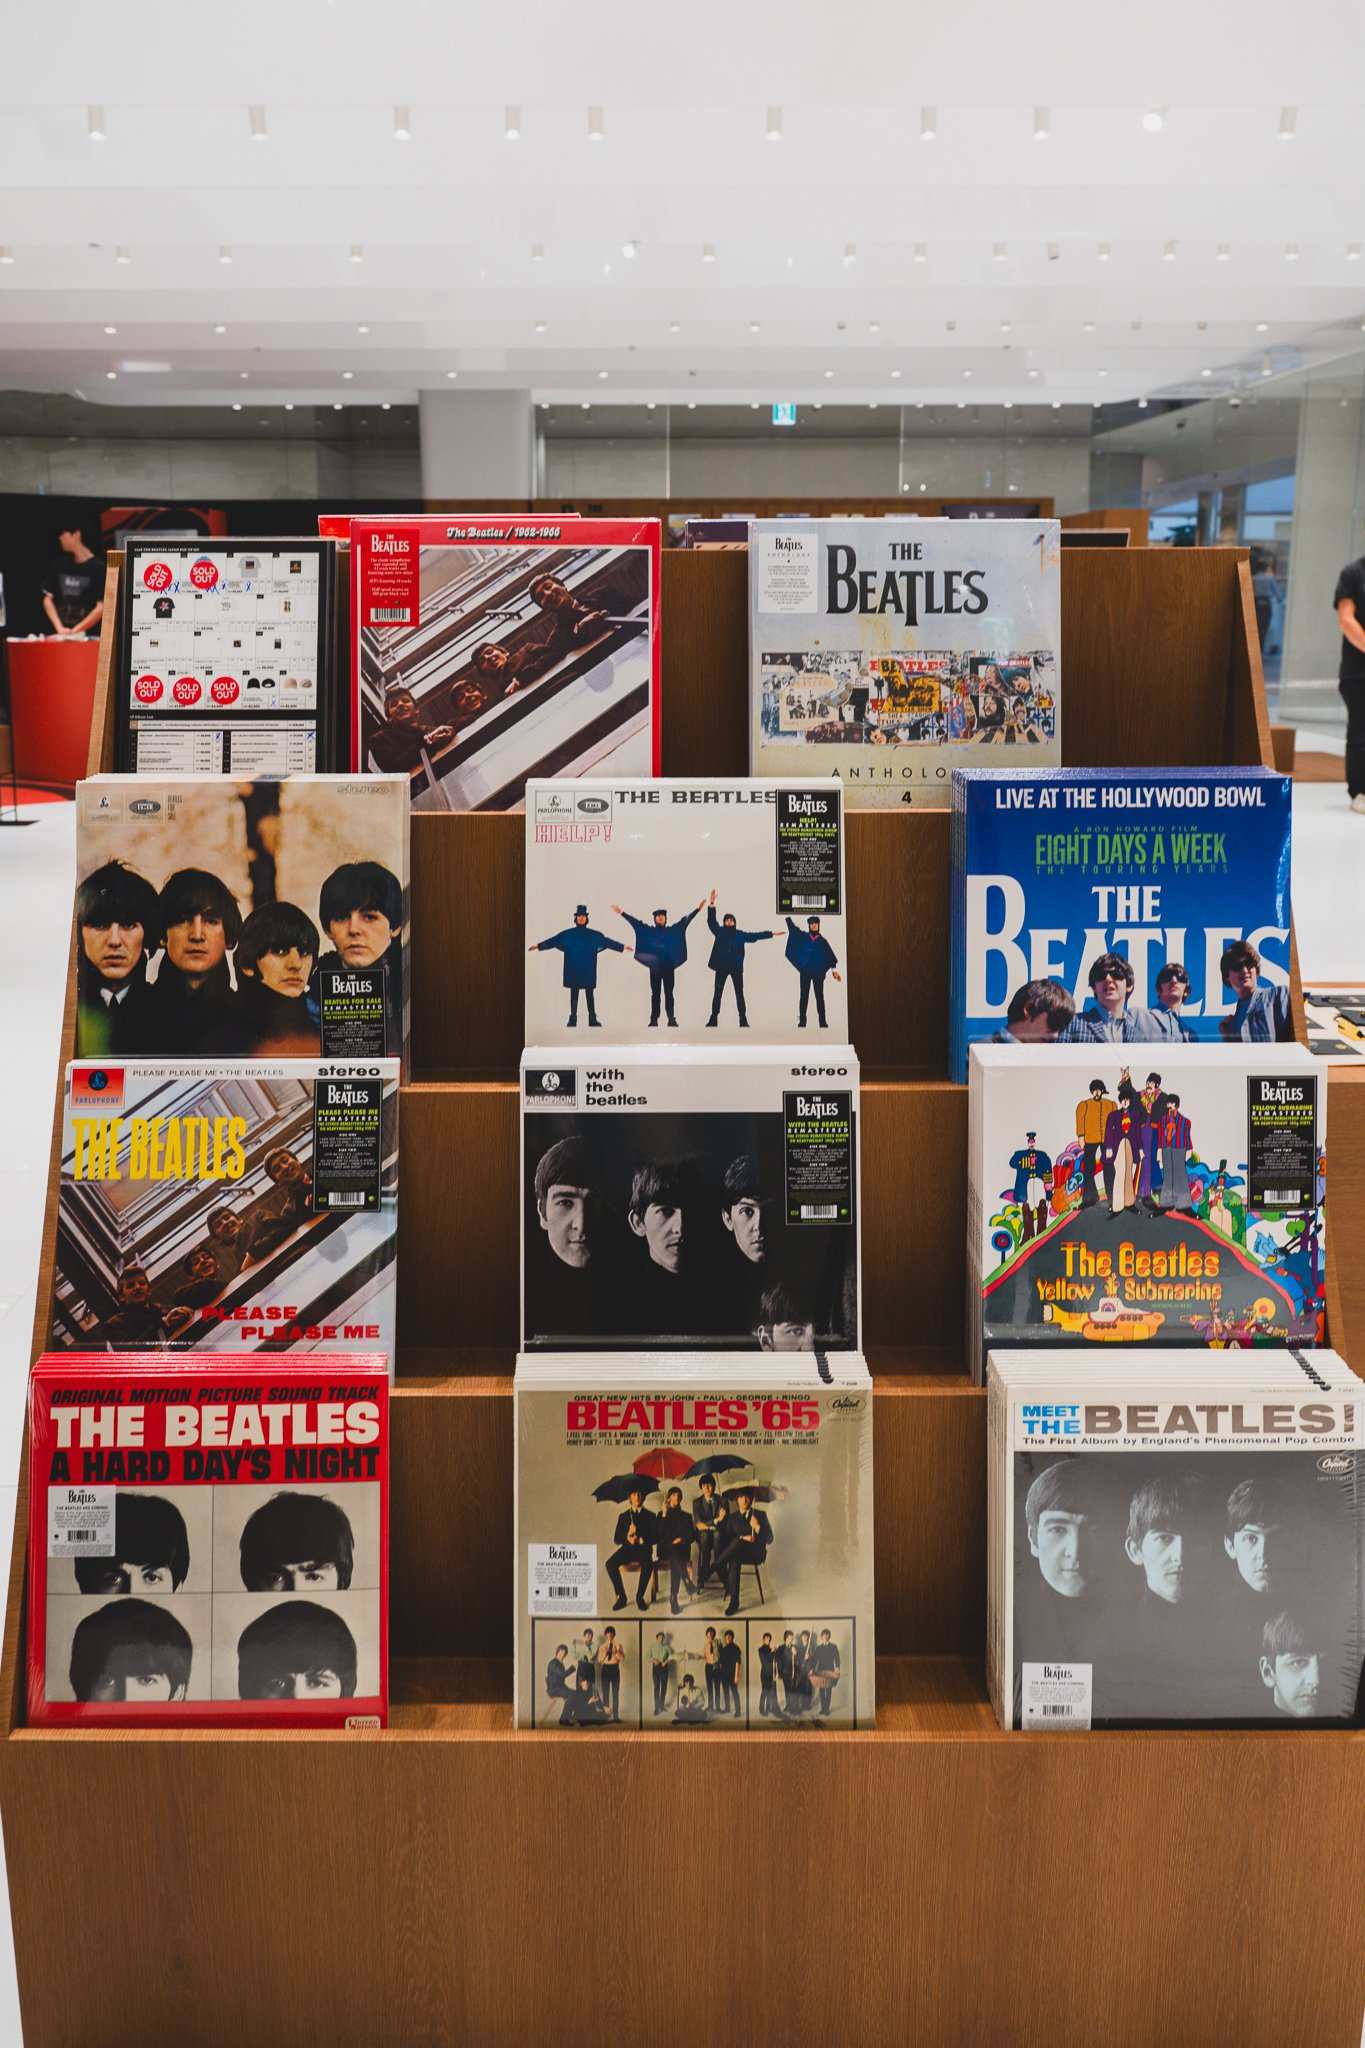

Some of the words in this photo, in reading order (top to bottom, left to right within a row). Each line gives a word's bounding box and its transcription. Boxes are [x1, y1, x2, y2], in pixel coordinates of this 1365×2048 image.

[447, 527, 466, 538] The
[468, 527, 504, 538] Beatles
[514, 527, 560, 538] 1962-1966
[372, 534, 410, 555] BEATLES
[776, 538, 802, 551] BEATLES
[888, 543, 922, 560] THE
[146, 564, 162, 587] SOLD
[156, 568, 168, 588] OUT
[192, 566, 216, 575] SOLD
[194, 575, 213, 583] OUT
[826, 544, 988, 626] BEATLES
[138, 680, 160, 689] SOLD
[176, 682, 199, 692] SOLD
[214, 682, 236, 691] SOLD
[140, 689, 157, 697] OUT
[178, 691, 196, 700] OUT
[216, 690, 234, 699] OUT
[832, 768, 947, 778] ANTHOLO
[615, 791, 660, 804] THE
[672, 791, 776, 804] BEATLES
[788, 794, 827, 815] BEATLES
[902, 791, 912, 803] 4
[996, 788, 1034, 809] LIVE
[1038, 788, 1061, 808] AT
[1063, 788, 1096, 808] THE
[1101, 787, 1209, 808] HOLLYWOOD
[1214, 786, 1266, 808] BOWL
[535, 825, 611, 842] HELP!
[1036, 834, 1092, 866] EIGHT
[1097, 834, 1147, 865] DAYS
[1152, 834, 1165, 864] A
[1171, 833, 1227, 864] WEEK
[1036, 865, 1065, 874] THE
[1082, 865, 1158, 874] TOURING
[1175, 865, 1228, 874] YEARS
[1091, 886, 1161, 922] THE
[966, 874, 1290, 1018] BEATLES
[332, 976, 372, 996] BEATLES
[318, 1065, 380, 1076] stereo
[586, 1069, 624, 1081] with
[790, 1065, 848, 1076] stereo
[586, 1082, 613, 1092] the
[1261, 1081, 1303, 1104] BEATLES
[328, 1085, 368, 1107] BEATLES
[525, 1095, 576, 1104] PARLOPHONE
[585, 1094, 647, 1106] beatles
[797, 1097, 838, 1119] BEATLES
[72, 1118, 123, 1181] THE
[130, 1116, 247, 1180] BEATLES
[1061, 1242, 1112, 1278] The
[1119, 1241, 1219, 1278] Beatles
[1036, 1277, 1096, 1300] Yellow
[1124, 1277, 1222, 1301] Submarine
[201, 1306, 298, 1321] PLEASE
[241, 1326, 337, 1340] PLEASE
[343, 1326, 380, 1338] ME
[51, 1389, 123, 1405] ORIGINAL
[130, 1388, 192, 1403] MOTION
[197, 1387, 263, 1402] PICTURE
[267, 1387, 321, 1401] SOUND
[327, 1386, 379, 1400] TRACK
[567, 1401, 748, 1430] BEATLES
[752, 1401, 820, 1430] '65
[1023, 1406, 1079, 1417] MEET
[1084, 1404, 1354, 1434] BEATLES!
[50, 1406, 144, 1448] THE
[165, 1401, 380, 1447] BEATLES
[1023, 1420, 1081, 1434] THE
[1142, 1437, 1200, 1445] England's
[1285, 1437, 1308, 1445] Pop
[50, 1452, 79, 1482] A
[83, 1451, 170, 1481] HARD
[183, 1448, 271, 1480] DAY'S
[284, 1446, 380, 1479] NIGHT
[69, 1489, 96, 1505] BEATLES
[549, 1546, 577, 1561] BEATLES
[1044, 1665, 1072, 1680] BEATLES
